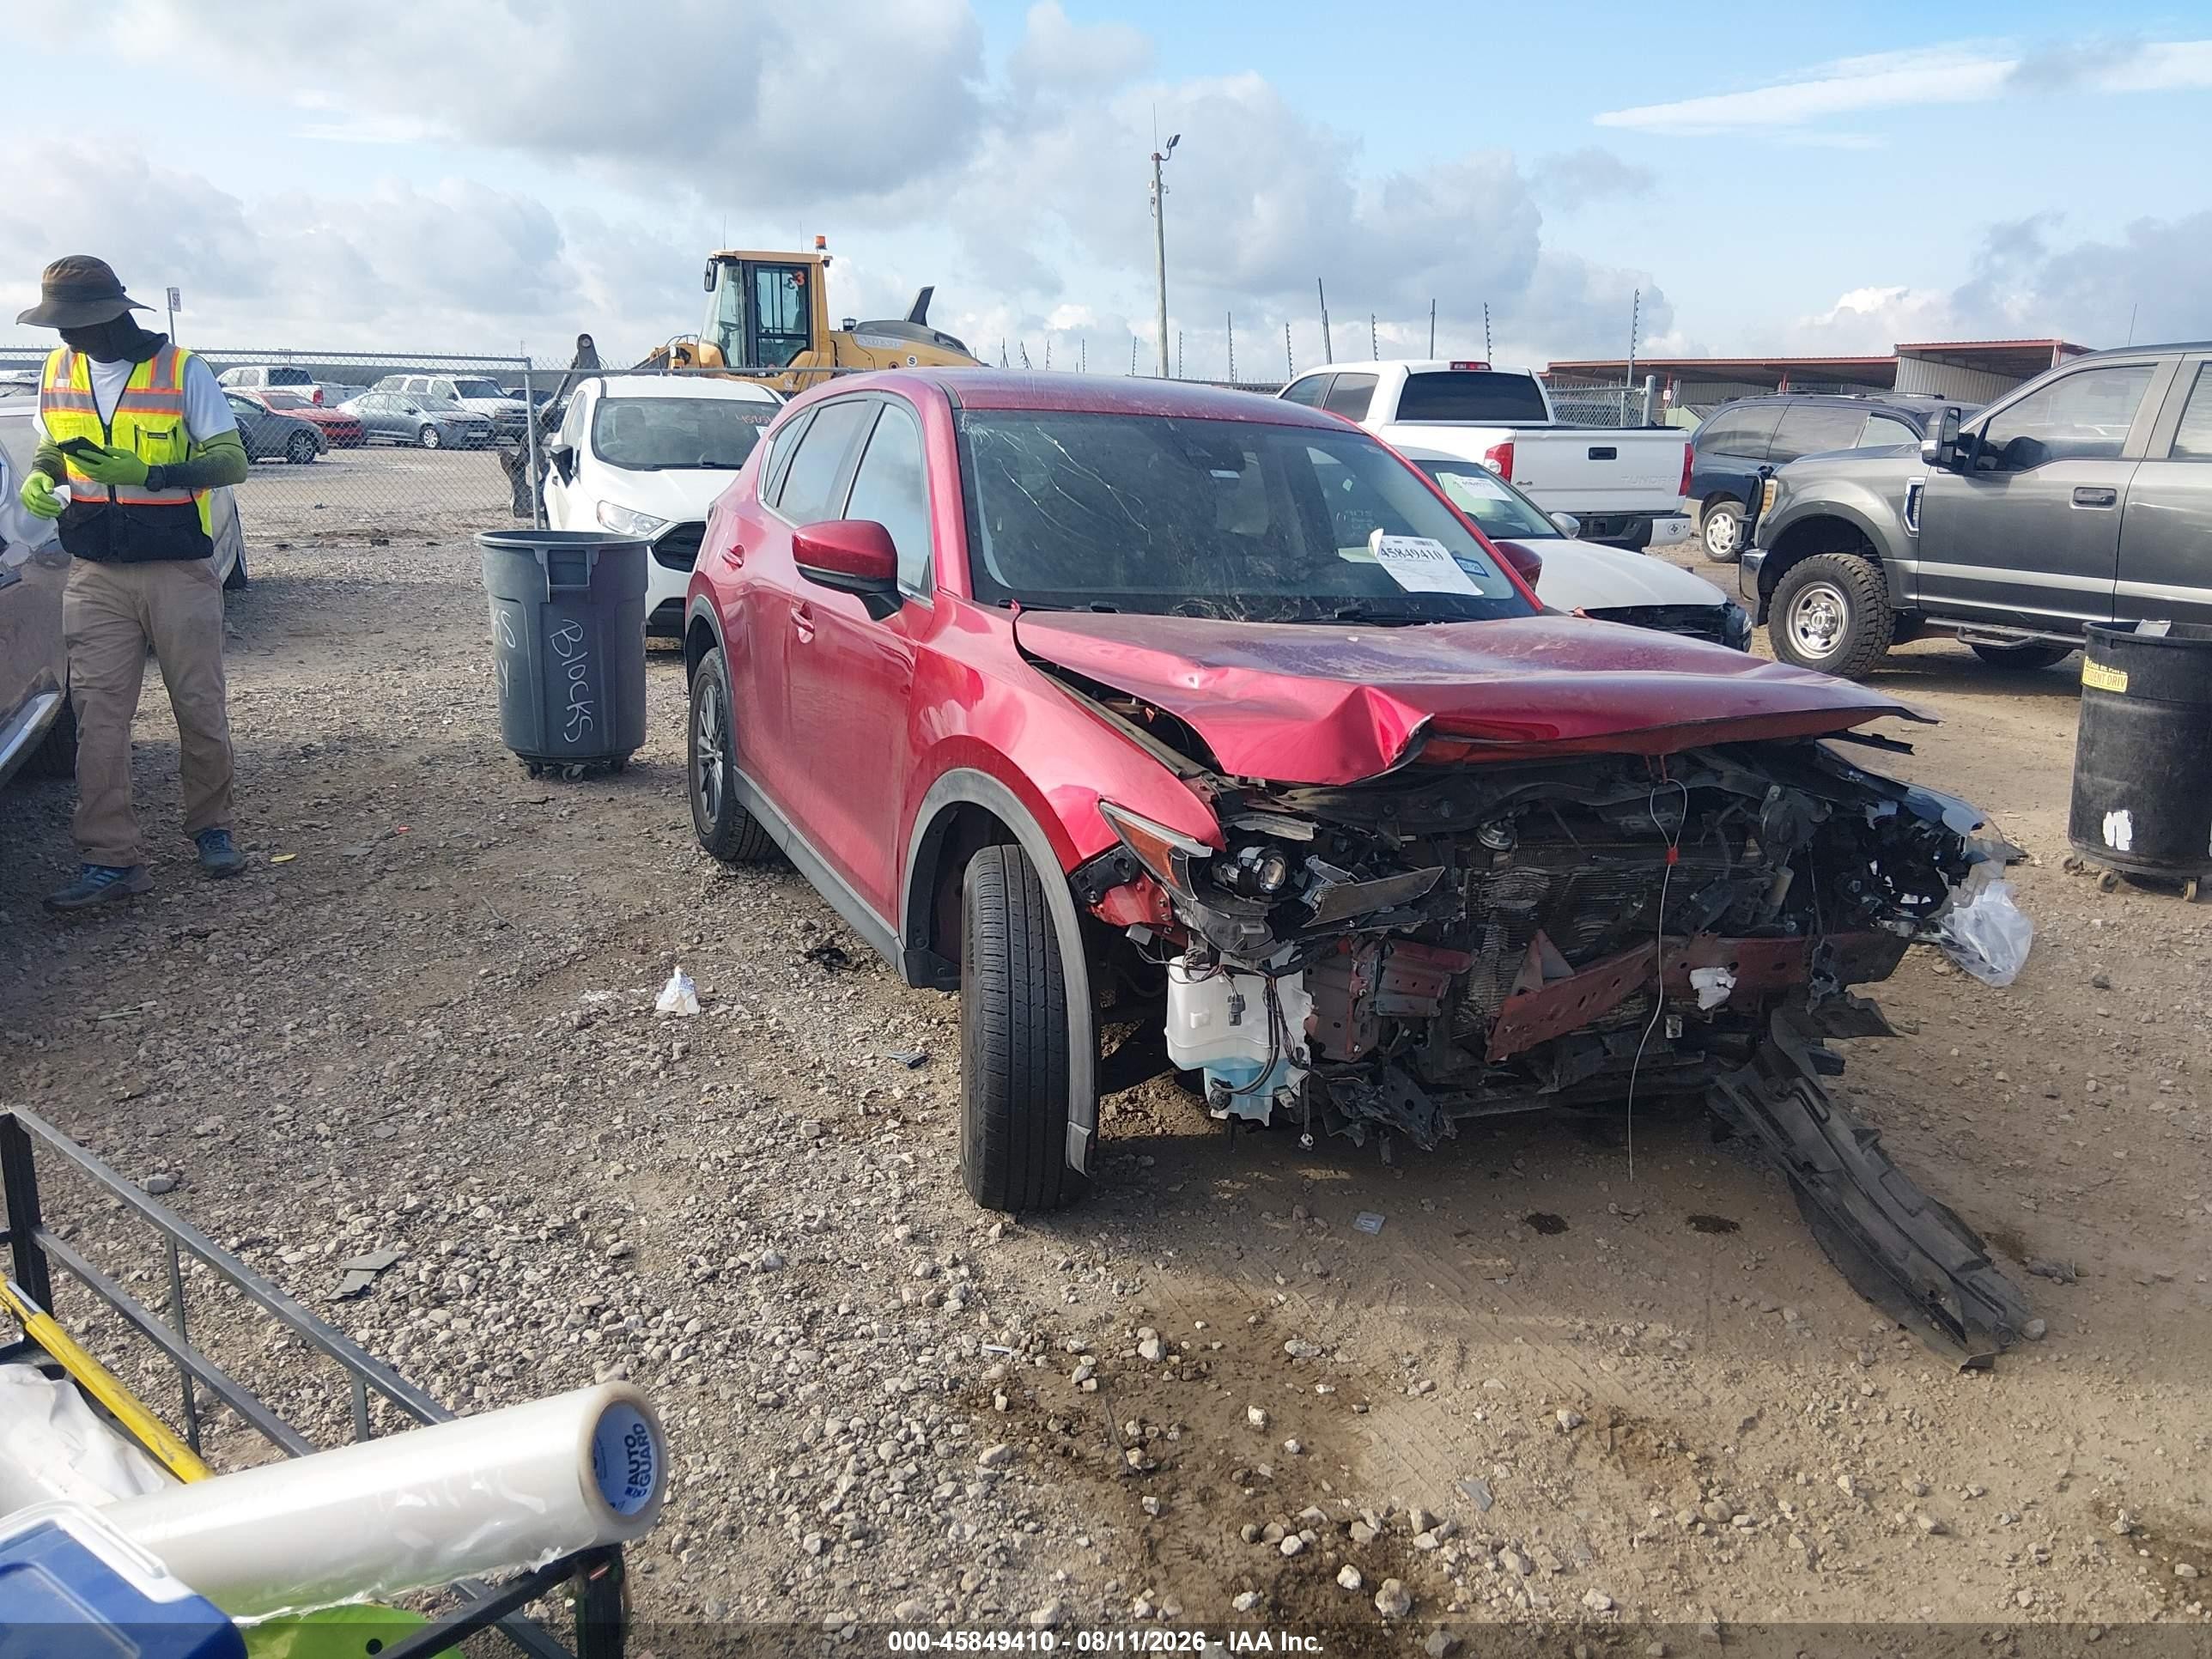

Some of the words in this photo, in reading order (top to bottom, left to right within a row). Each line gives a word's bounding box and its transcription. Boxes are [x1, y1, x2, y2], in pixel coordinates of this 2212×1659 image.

[1381, 548, 1444, 561] 45849410
[624, 1433, 641, 1486] AUTO
[633, 1423, 653, 1489] GUARD
